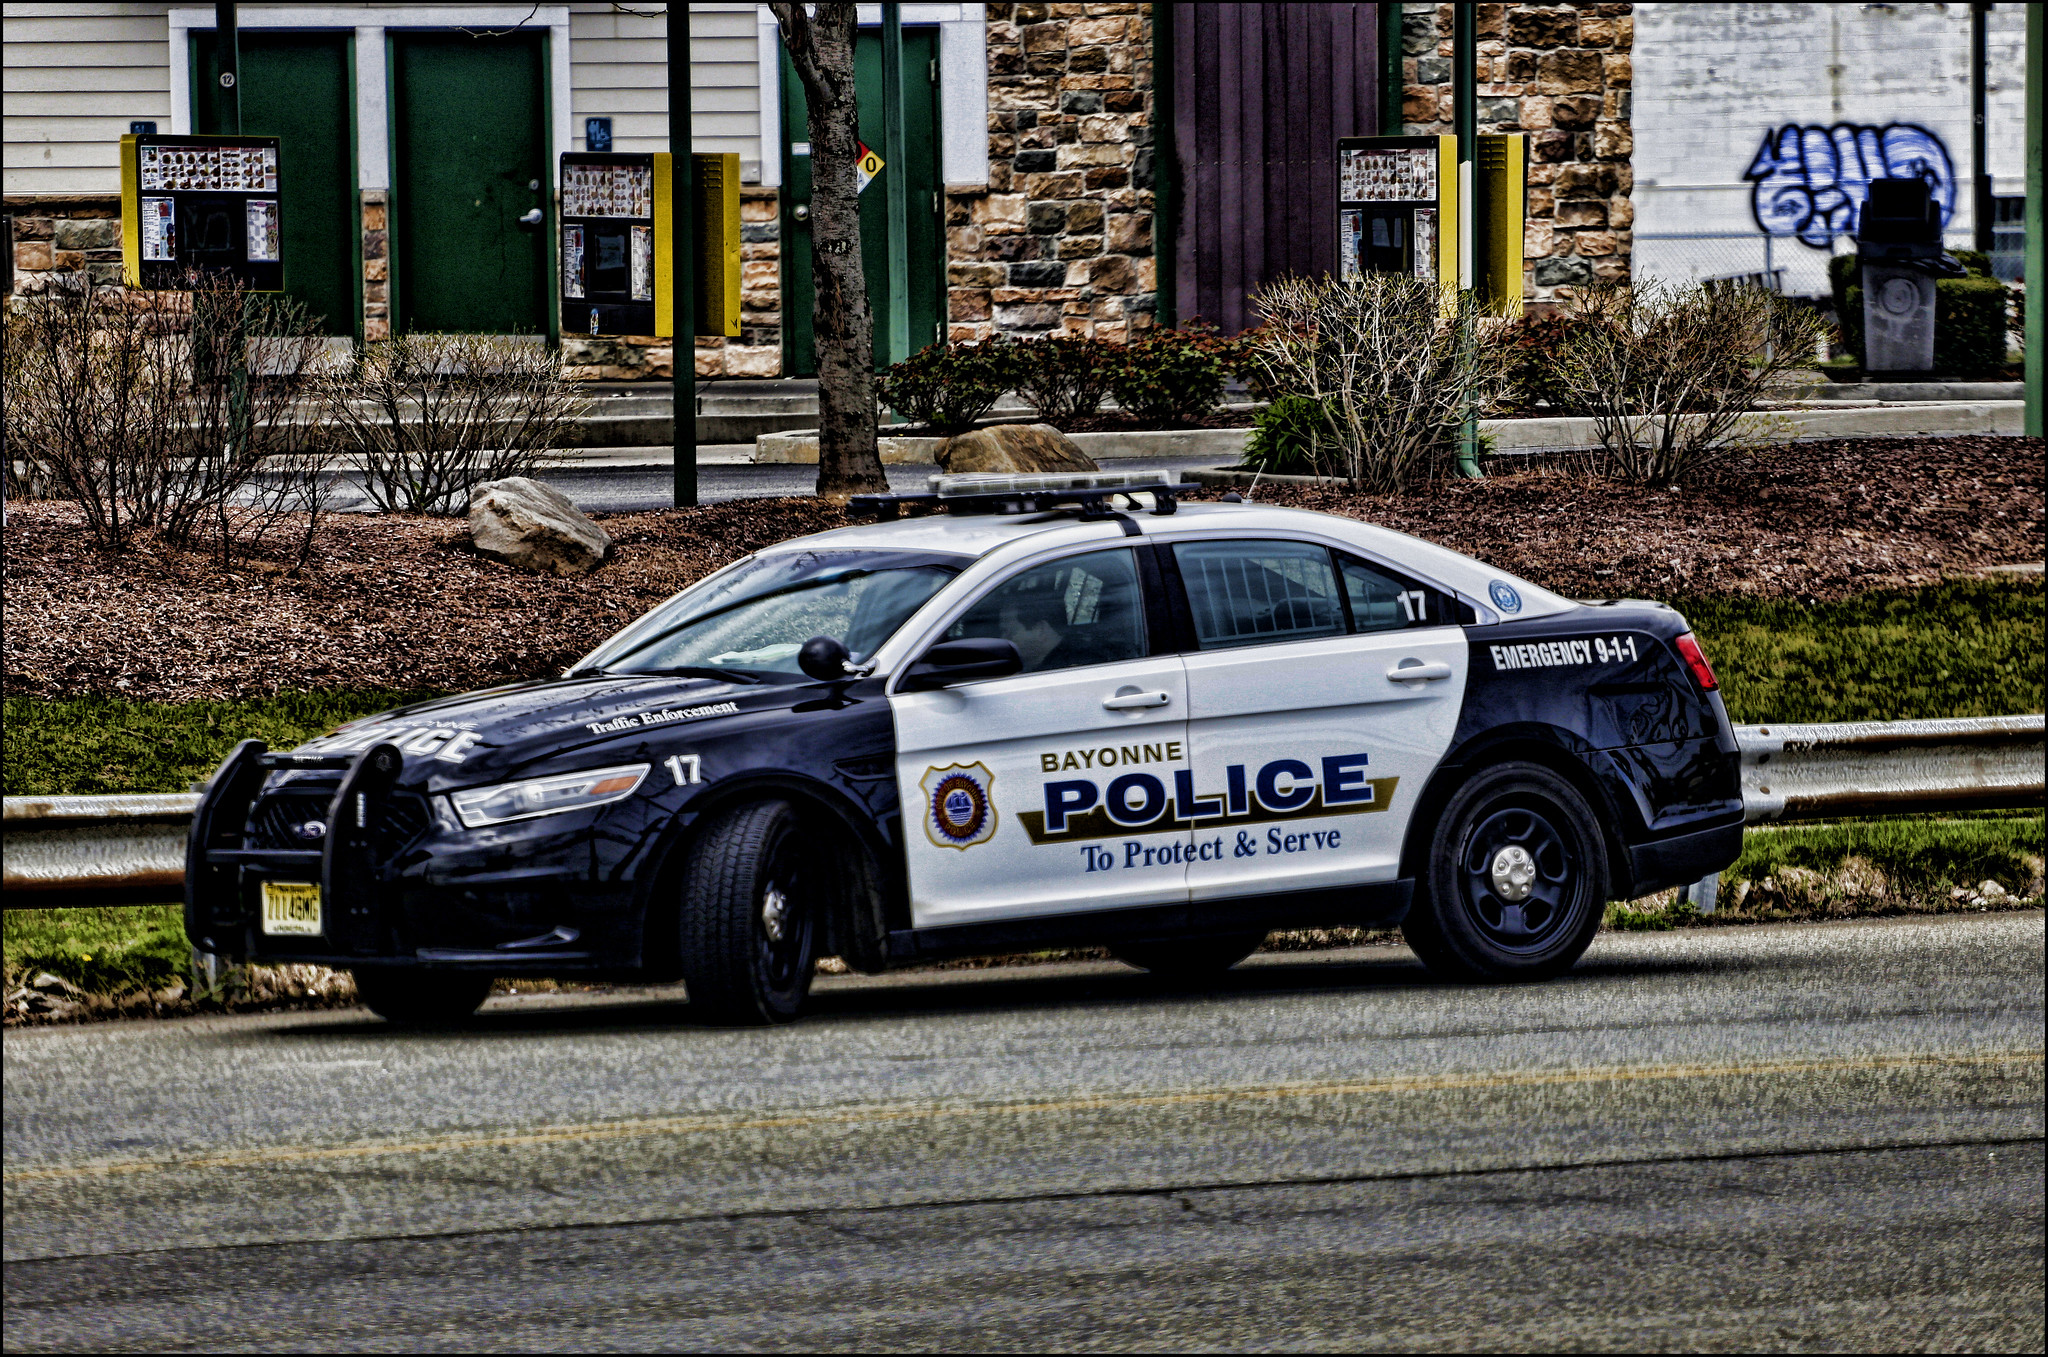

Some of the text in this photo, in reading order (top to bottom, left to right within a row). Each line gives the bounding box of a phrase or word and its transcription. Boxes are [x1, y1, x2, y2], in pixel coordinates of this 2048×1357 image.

[222, 74, 233, 85] 12
[865, 156, 877, 172] 0
[1397, 590, 1427, 622] 17
[1489, 636, 1638, 671] EMERGENCY 9-1-1
[586, 701, 740, 735] Traffic Enforcement
[664, 754, 701, 786] 17
[1040, 741, 1183, 773] BAYONNE
[1043, 753, 1375, 834] POLICE
[1081, 827, 1342, 873] To Protect & Serve
